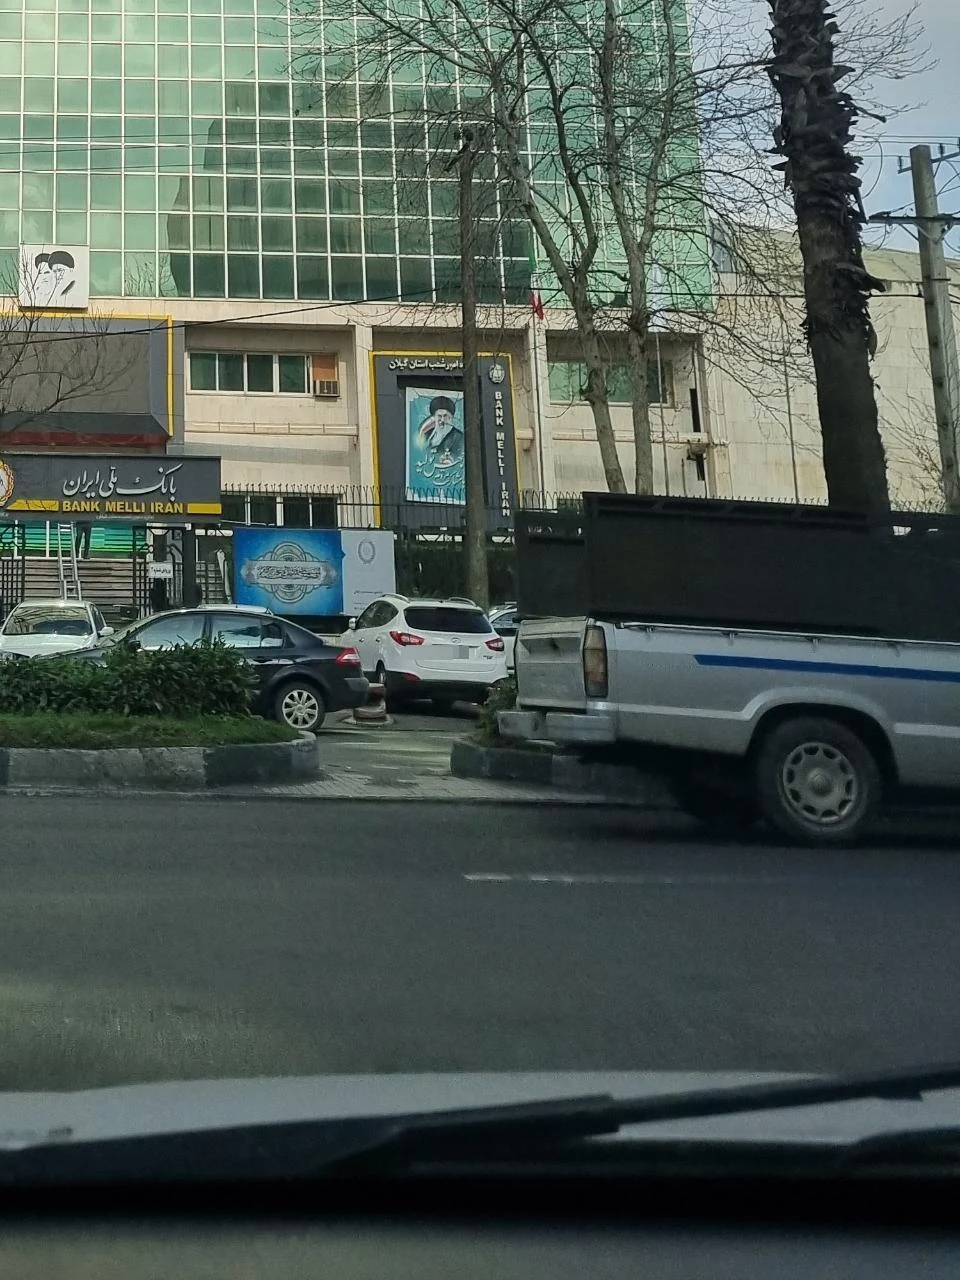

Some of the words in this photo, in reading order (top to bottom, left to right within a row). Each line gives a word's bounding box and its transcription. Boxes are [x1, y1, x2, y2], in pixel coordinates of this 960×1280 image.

[388, 357, 408, 371] گیلان
[409, 358, 428, 369] استان
[494, 391, 504, 426] BANK
[496, 431, 505, 476] MELLI
[63, 470, 100, 499] ایران
[116, 463, 184, 501] بانک
[62, 500, 101, 513] BANK
[105, 501, 146, 513] MELLI
[150, 503, 184, 514] IRAN
[501, 482, 511, 517] IRAN
